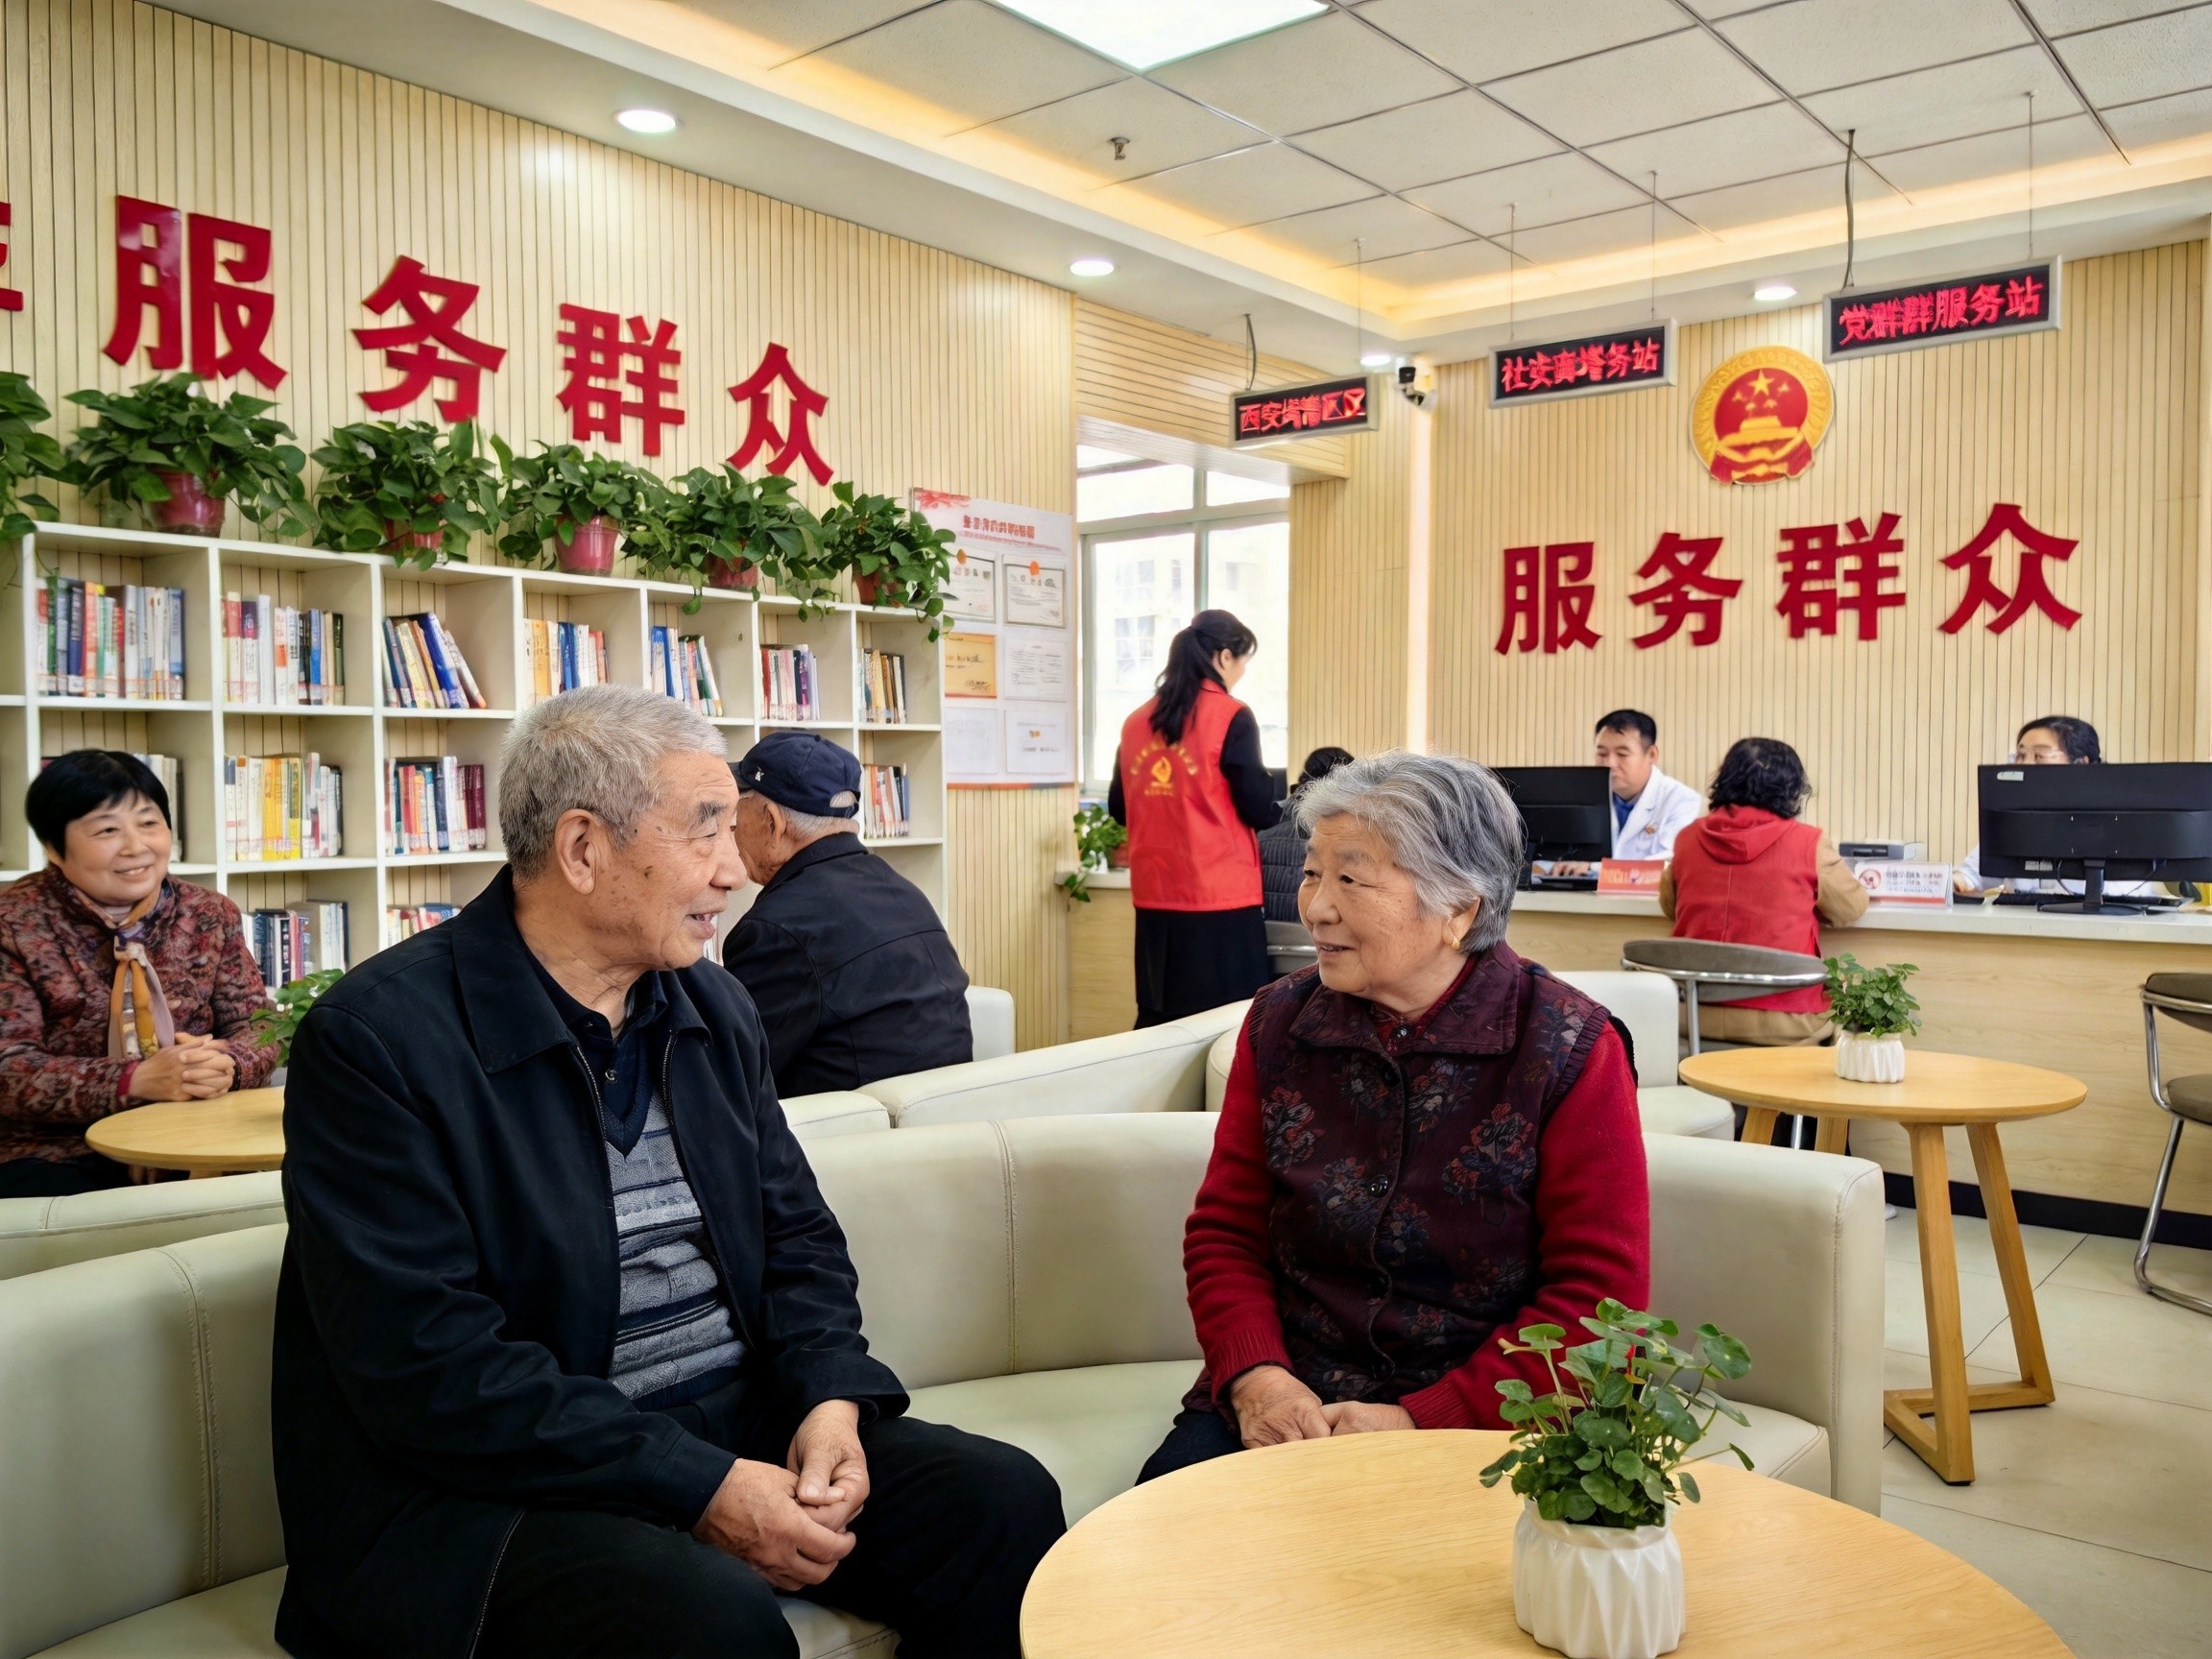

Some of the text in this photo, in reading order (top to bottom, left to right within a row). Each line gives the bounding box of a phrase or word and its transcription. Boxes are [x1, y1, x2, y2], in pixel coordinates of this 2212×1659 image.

[0, 195, 834, 488] 服务群众
[1494, 502, 2081, 656] 服务群众
